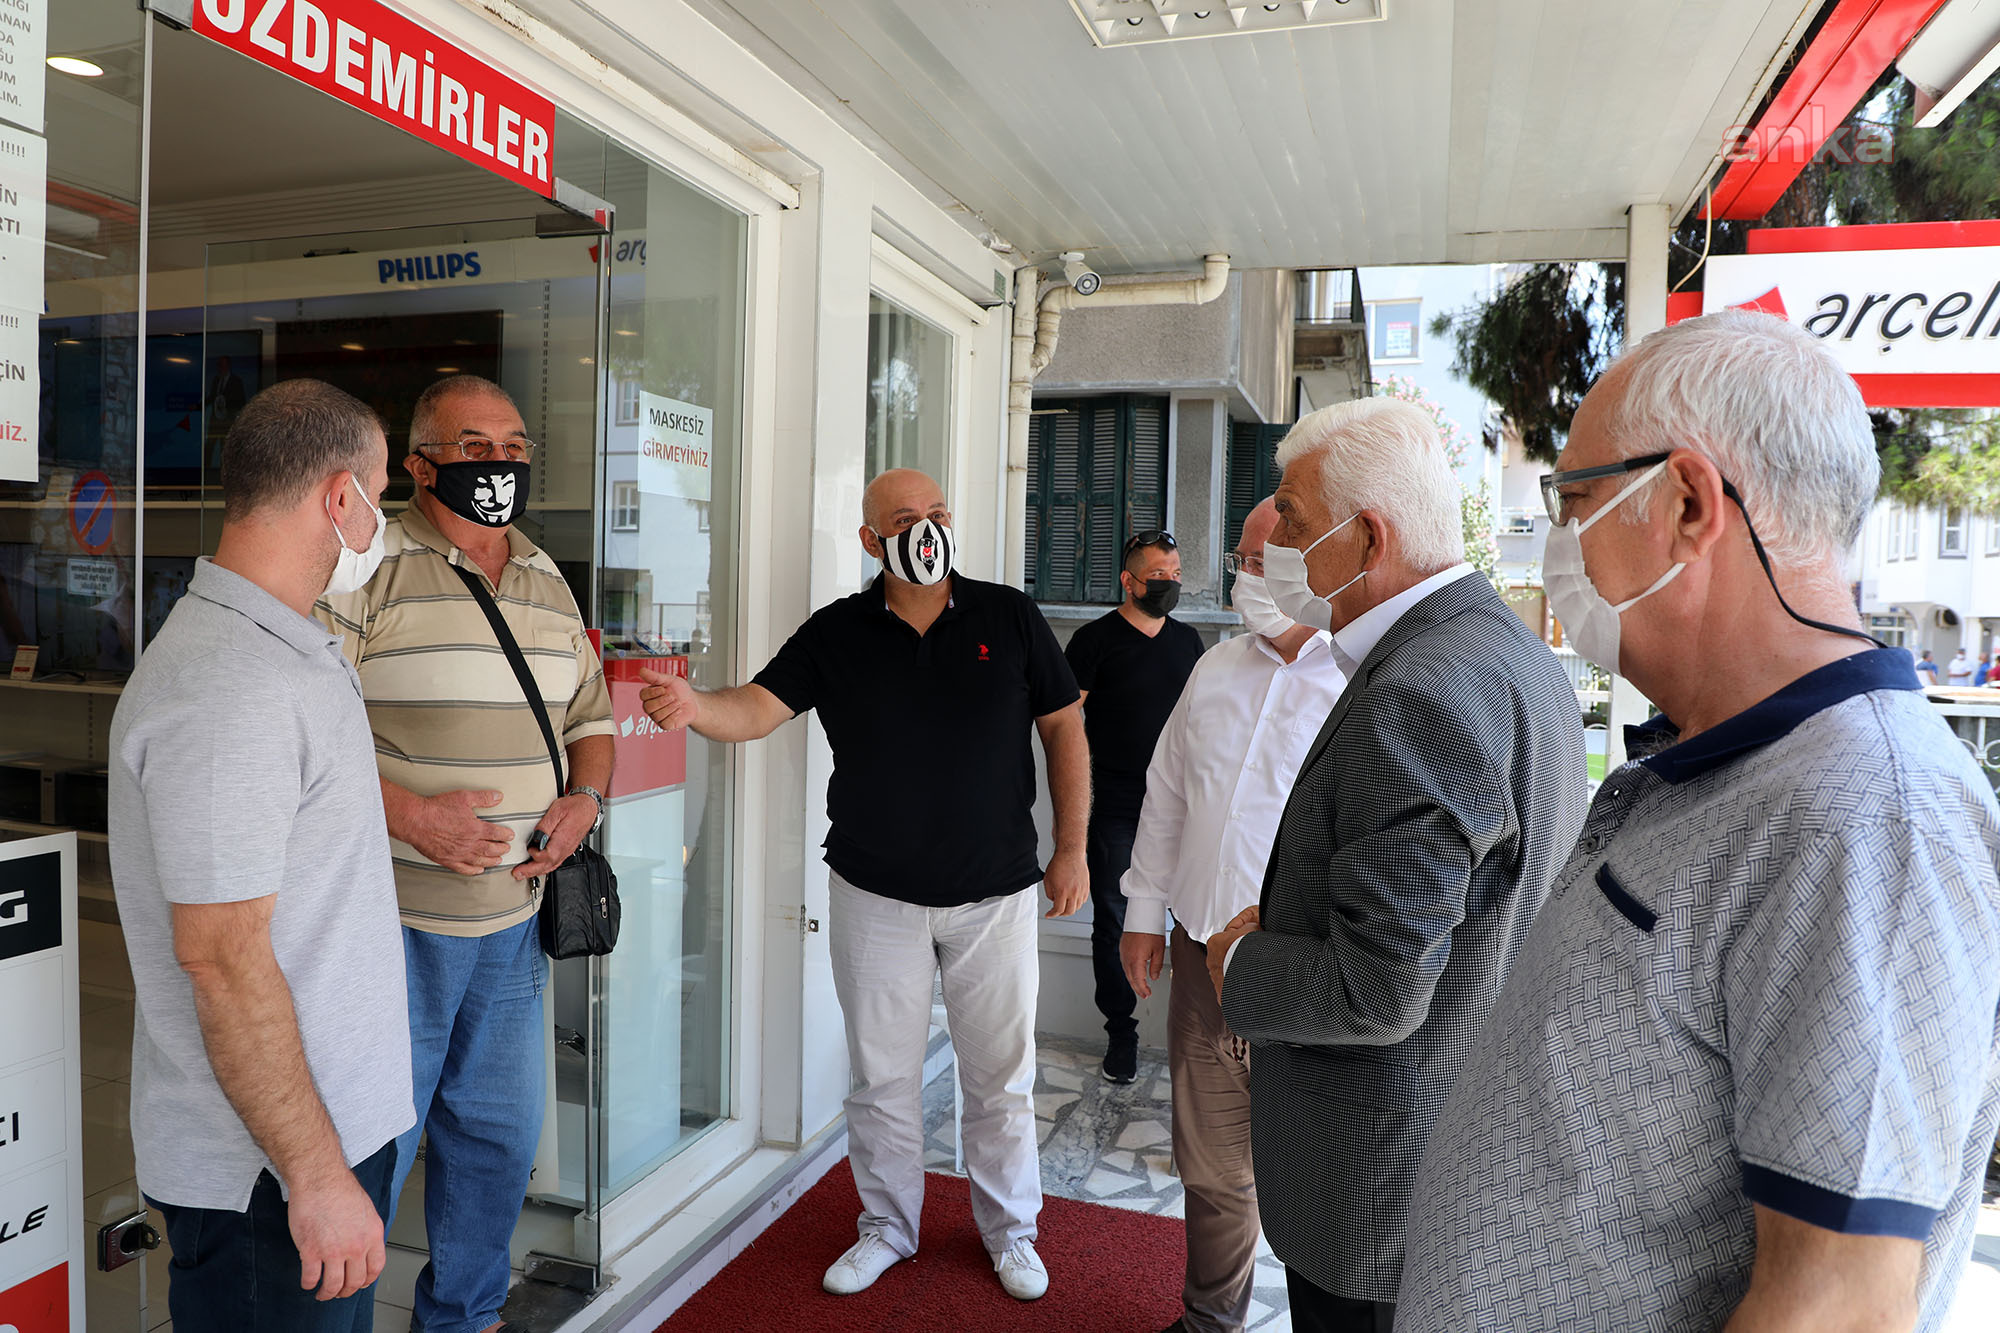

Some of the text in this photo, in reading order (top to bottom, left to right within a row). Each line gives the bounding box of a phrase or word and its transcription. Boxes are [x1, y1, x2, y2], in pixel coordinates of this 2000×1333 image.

[378, 252, 482, 284] PHILIPS
[649, 407, 704, 436] MASKESİZ
[642, 437, 709, 468] GİRMEYİNİZ
